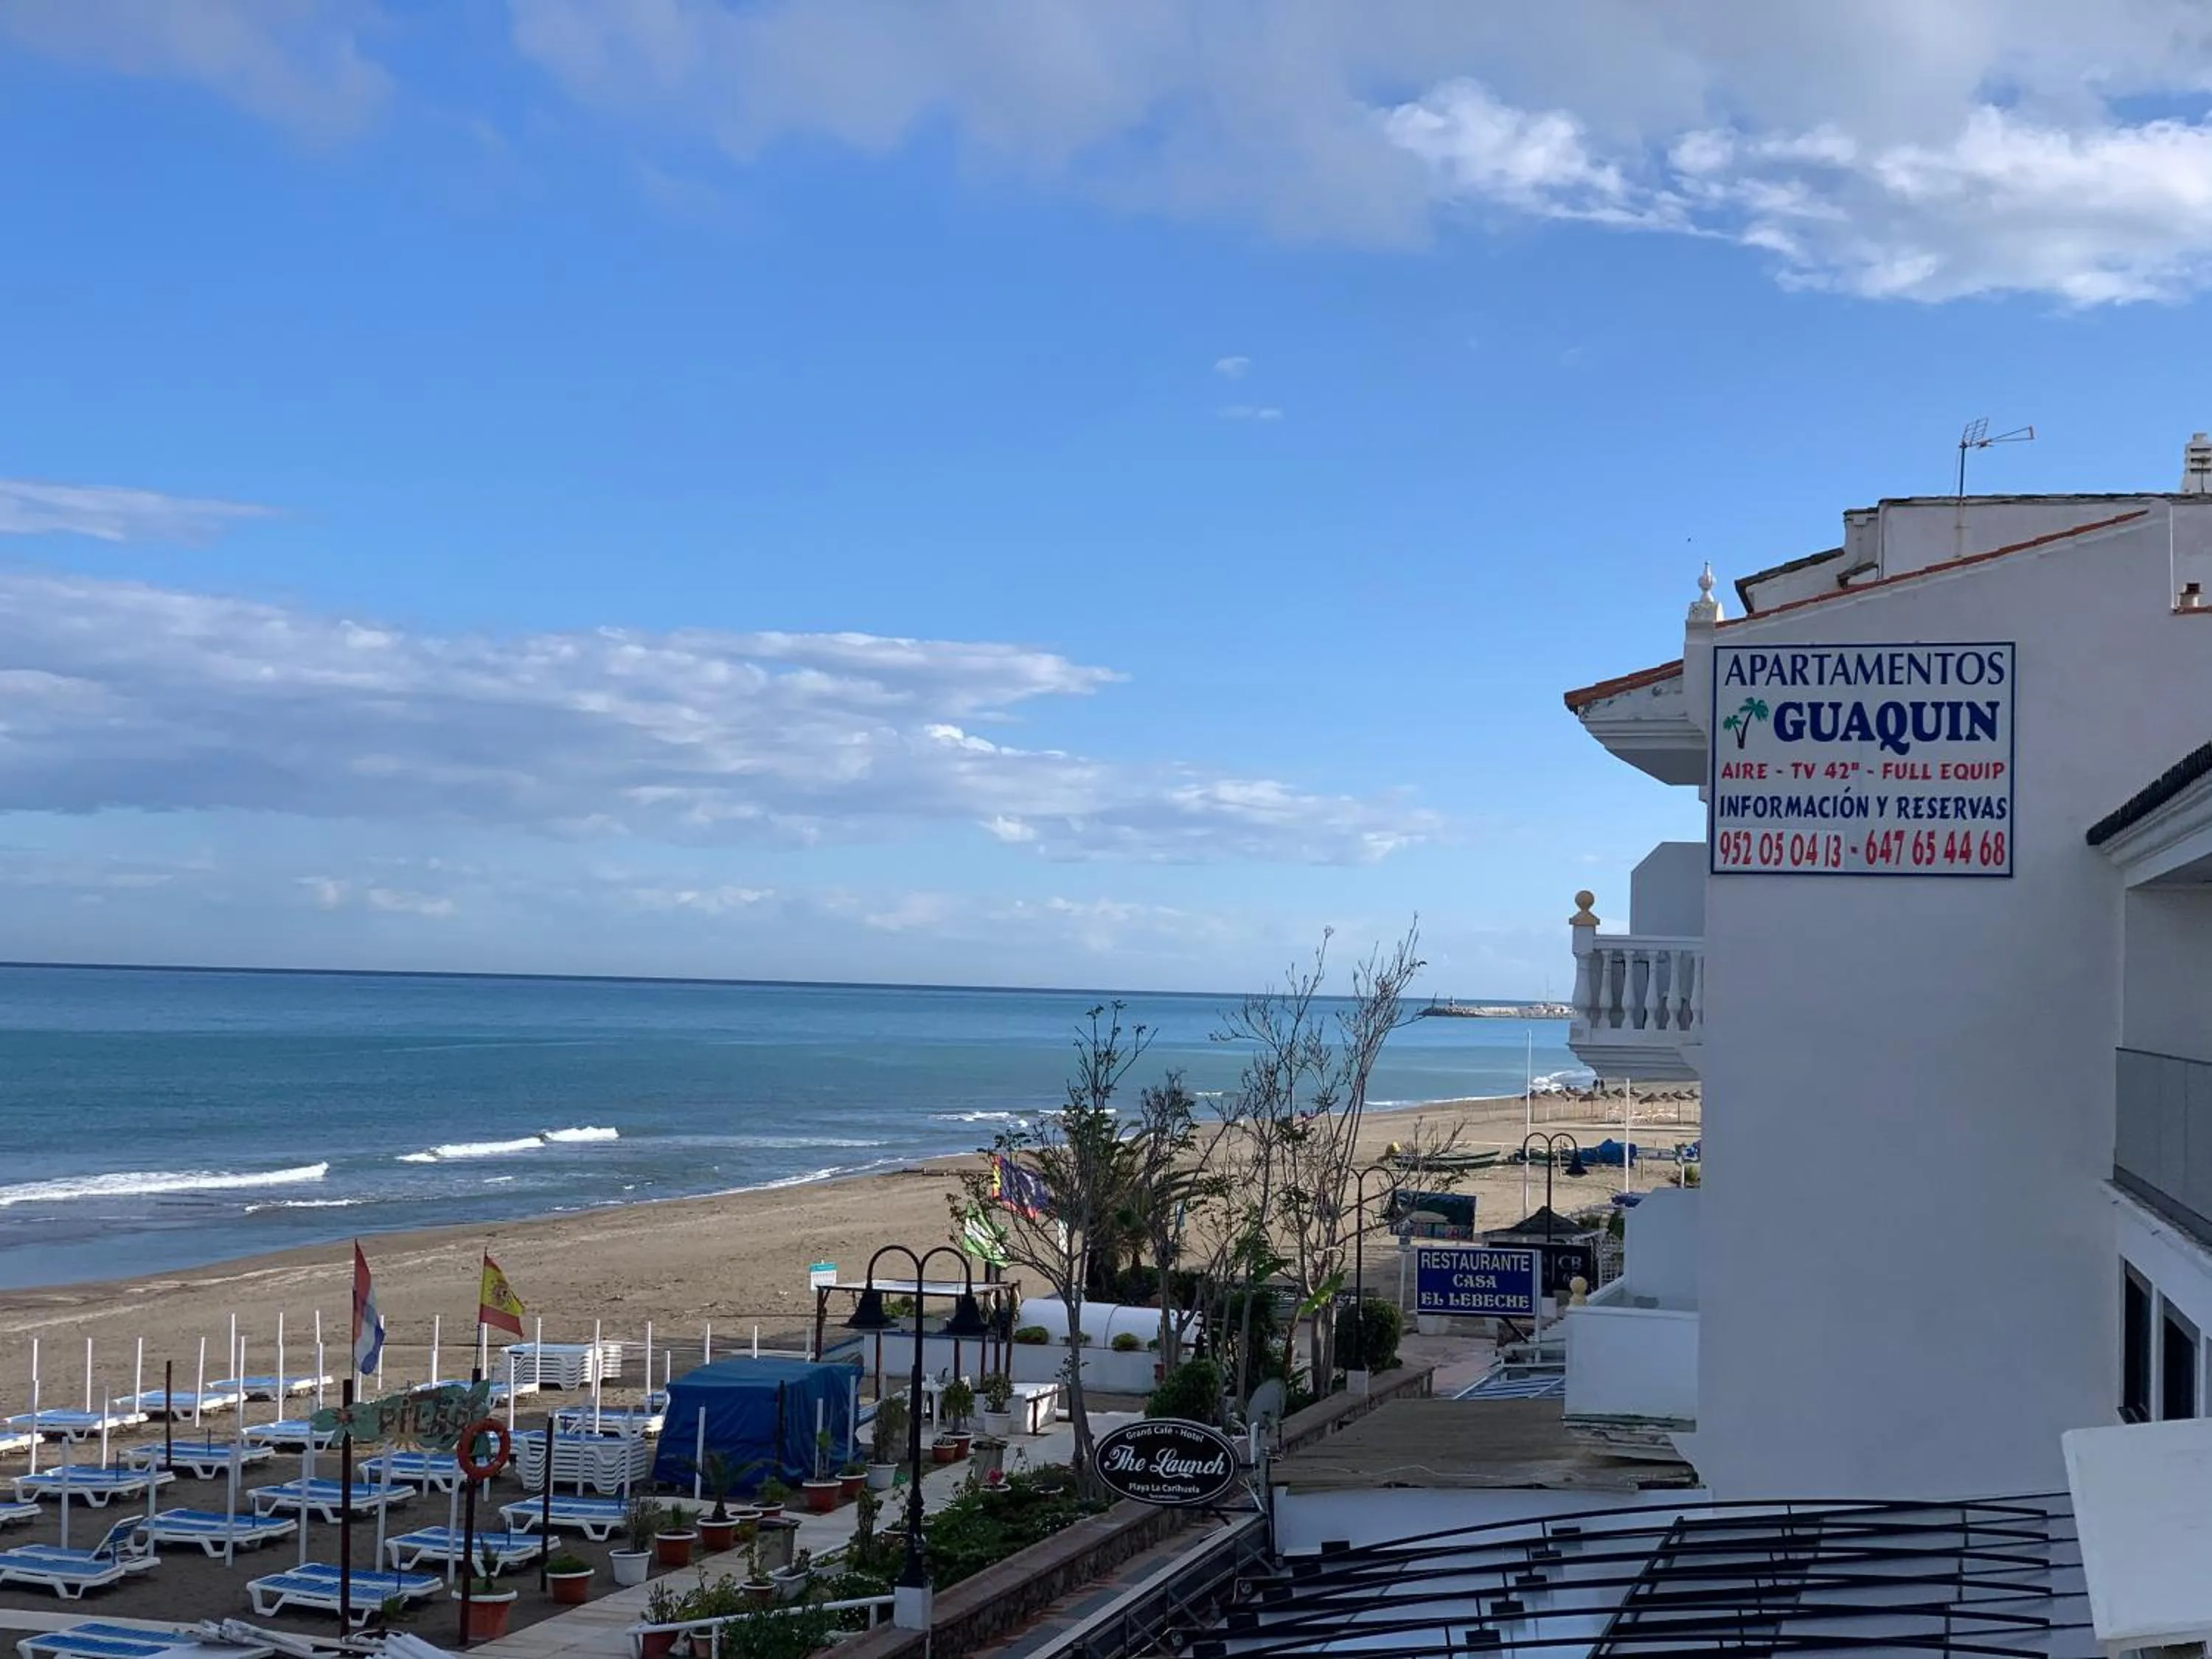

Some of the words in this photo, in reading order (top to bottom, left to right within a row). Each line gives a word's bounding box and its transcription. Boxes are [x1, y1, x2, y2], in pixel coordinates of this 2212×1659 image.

[1724, 652, 2005, 686] APARTAMENTOS
[1773, 701, 2000, 756] GUAQUIN
[1721, 762, 1768, 779] AIRE
[1791, 762, 1816, 779] TV
[1882, 762, 1932, 780] FULL
[1940, 762, 2006, 780] EQUIP
[1719, 786, 1870, 819] INFORMACIÓN
[1877, 796, 1889, 818] Y
[1896, 796, 2007, 821] RESERVAS
[1719, 830, 1752, 866] 952
[1759, 832, 1784, 866] 05
[1790, 833, 1818, 866] 04
[1825, 834, 1842, 868] 13
[1865, 830, 1905, 866] 647
[1913, 830, 1935, 866] 65
[1943, 830, 1972, 866] 44
[1979, 830, 2006, 866] 68
[1421, 1251, 1530, 1272] RESTAURANTE
[1452, 1273, 1498, 1289] CASA
[1421, 1291, 1444, 1306] EL
[1448, 1292, 1530, 1309] LEBECHE
[1126, 1427, 1152, 1440] Grand
[1180, 1428, 1204, 1443] Hotel
[1104, 1444, 1147, 1472] The
[1150, 1447, 1226, 1478] Launch
[1129, 1482, 1150, 1493] Playa
[1151, 1483, 1161, 1492] La
[1162, 1484, 1200, 1493] Carihuela
